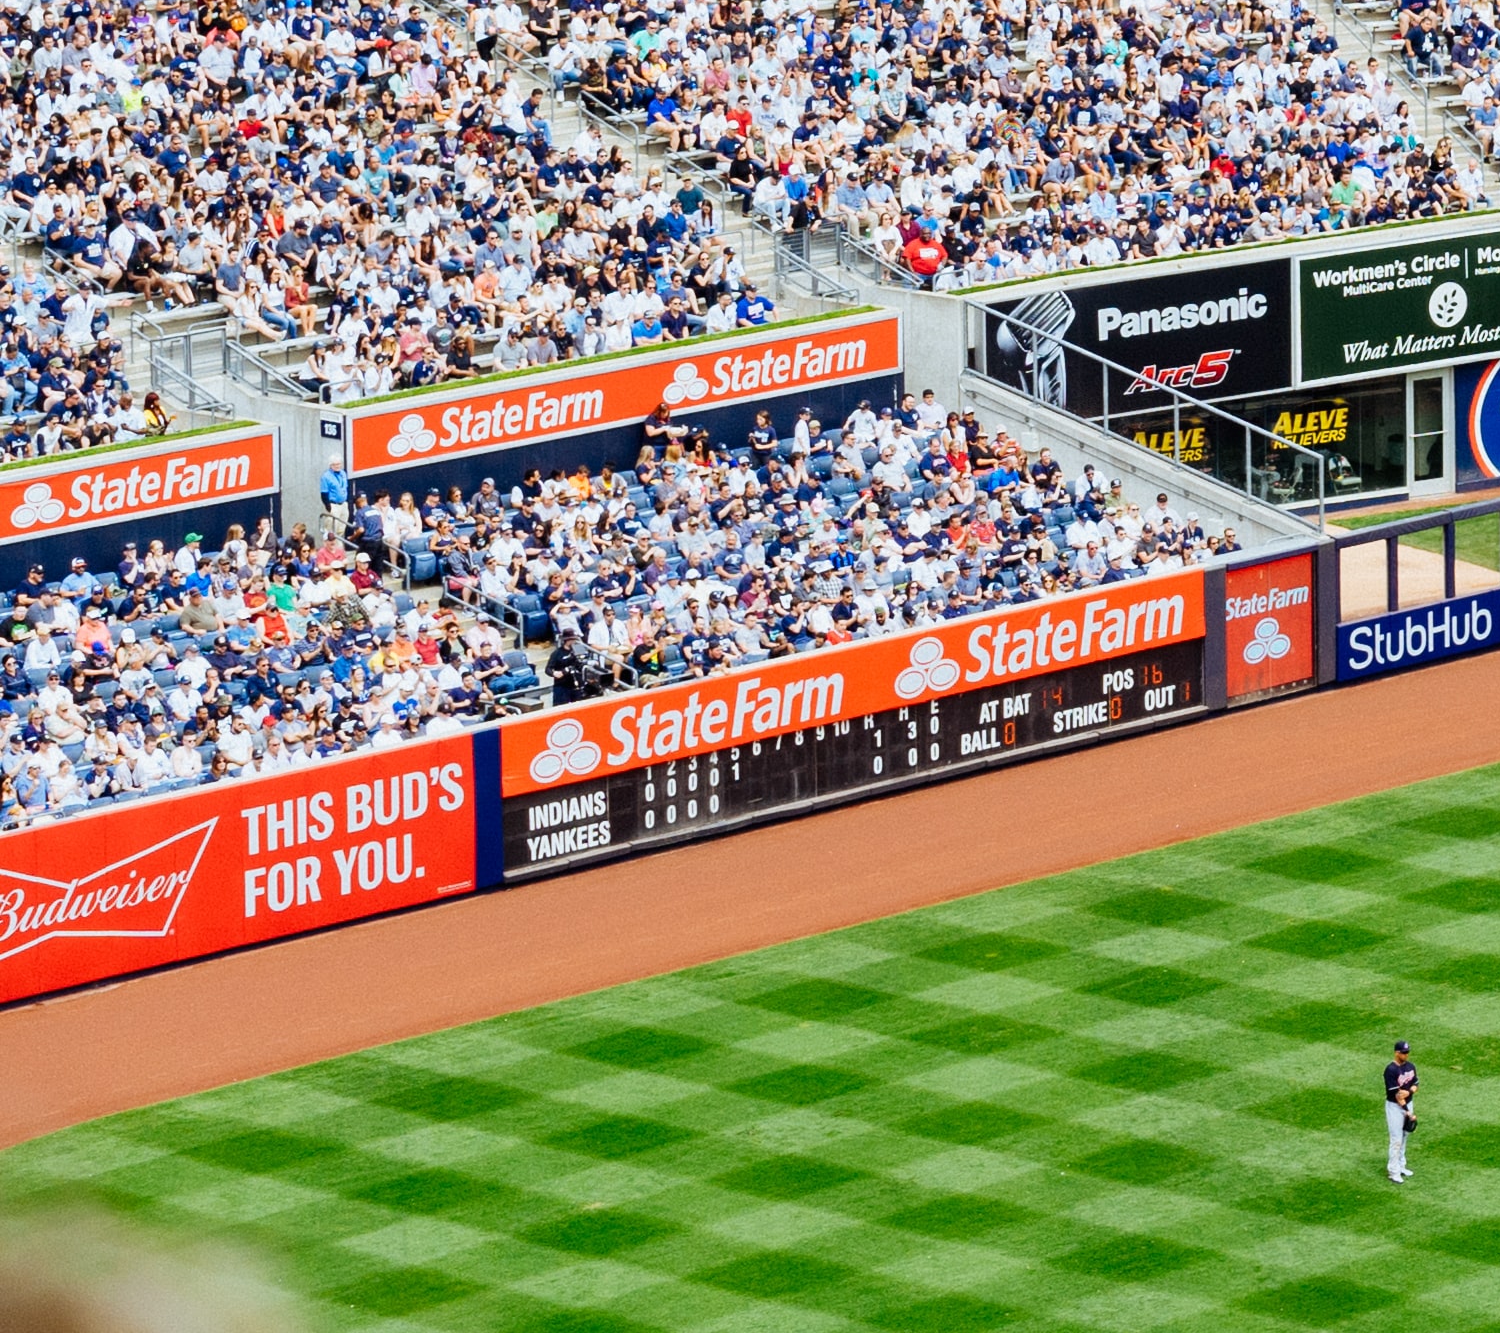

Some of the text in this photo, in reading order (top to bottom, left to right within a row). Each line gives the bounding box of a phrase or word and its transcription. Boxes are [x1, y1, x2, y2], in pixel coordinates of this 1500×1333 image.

[1313, 252, 1460, 288] Workmen's Circle
[1343, 274, 1433, 297] MultiCare Center
[1098, 288, 1267, 342] Panasonic
[1348, 599, 1493, 671] StubHub
[241, 791, 334, 855] THIS
[244, 834, 426, 917] FOR YOU.
